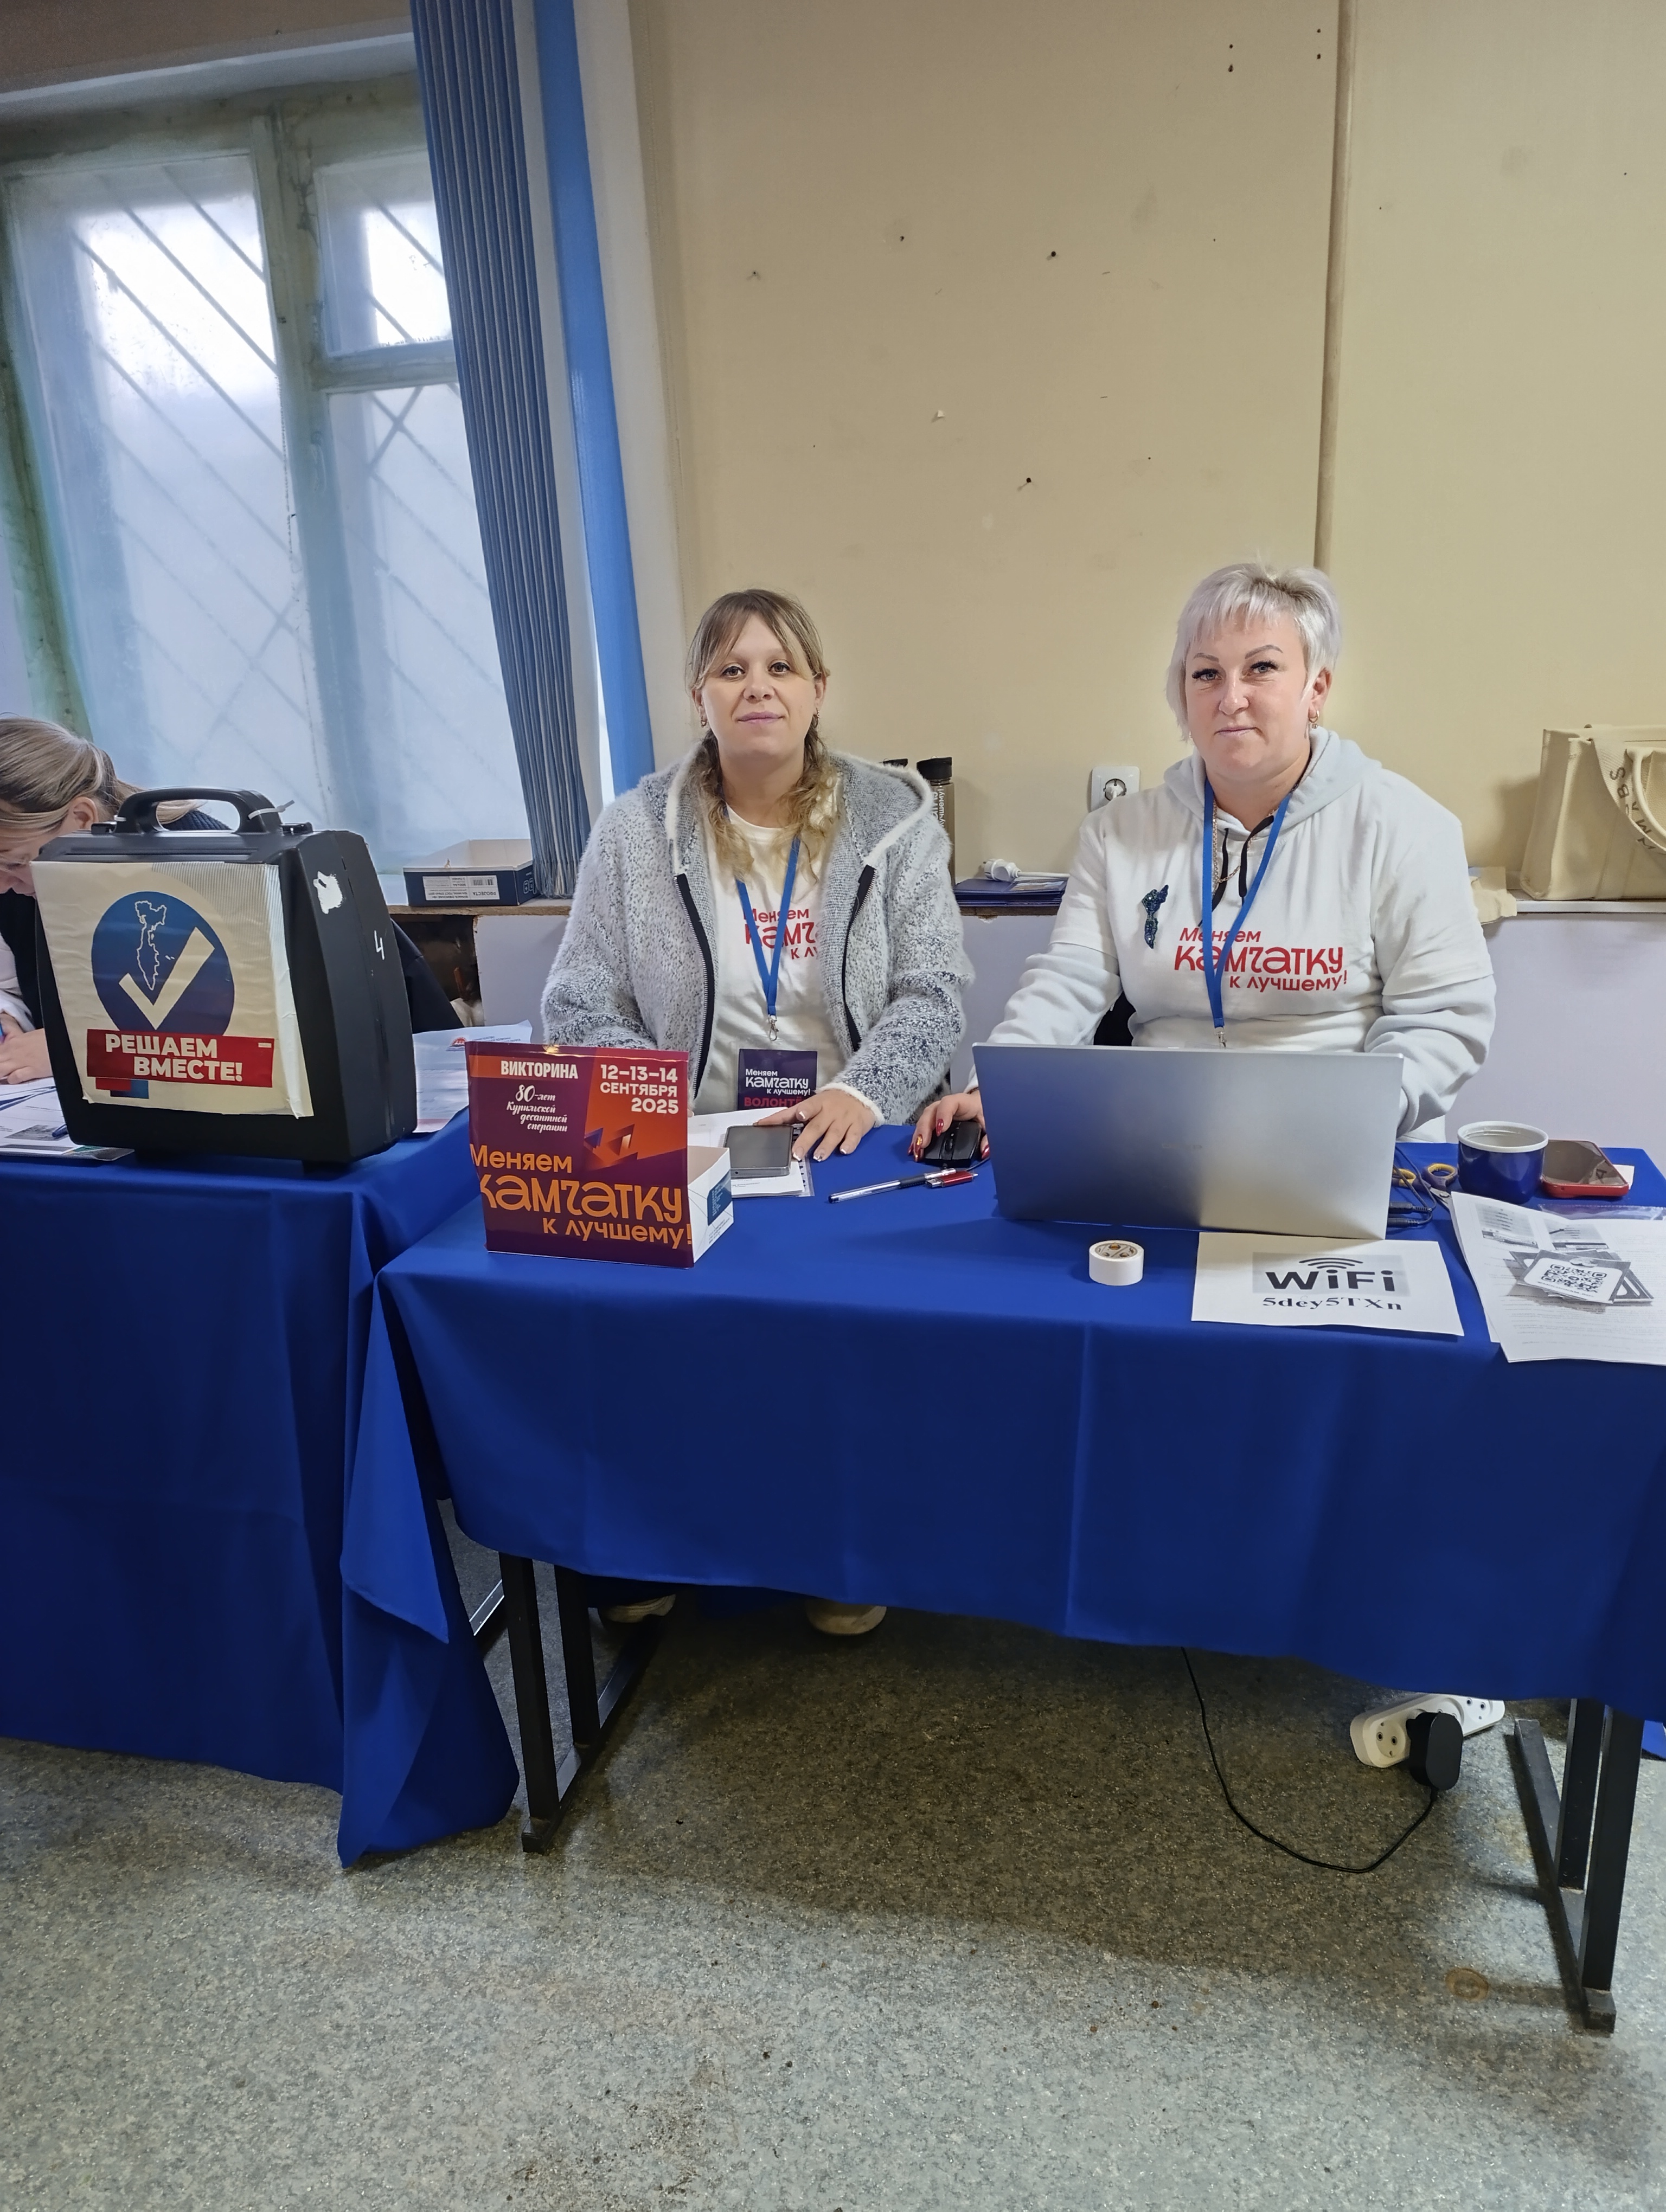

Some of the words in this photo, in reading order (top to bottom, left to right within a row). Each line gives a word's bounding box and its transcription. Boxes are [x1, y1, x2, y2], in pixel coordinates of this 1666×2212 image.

[743, 908, 809, 923] енем
[1247, 970, 1348, 993] лучшему!
[105, 1033, 217, 1058] РЕШАЕМ
[134, 1056, 243, 1082] ВМЕСТЕ!
[501, 1060, 579, 1079] ВИКТОРИНА
[515, 1084, 556, 1102] 80-лет
[600, 1082, 677, 1097] СЕНТЯБРЯ
[773, 1088, 810, 1096] лучшему!
[506, 1101, 556, 1115] Курильской
[631, 1097, 679, 1114] 2025
[744, 1096, 803, 1107] ВОЛОНТЁ
[520, 1114, 567, 1124] десантной
[527, 1123, 568, 1133] операции
[470, 1144, 572, 1174] Меняем
[565, 1219, 693, 1249] лучшему!
[1265, 1269, 1395, 1292] WiFi
